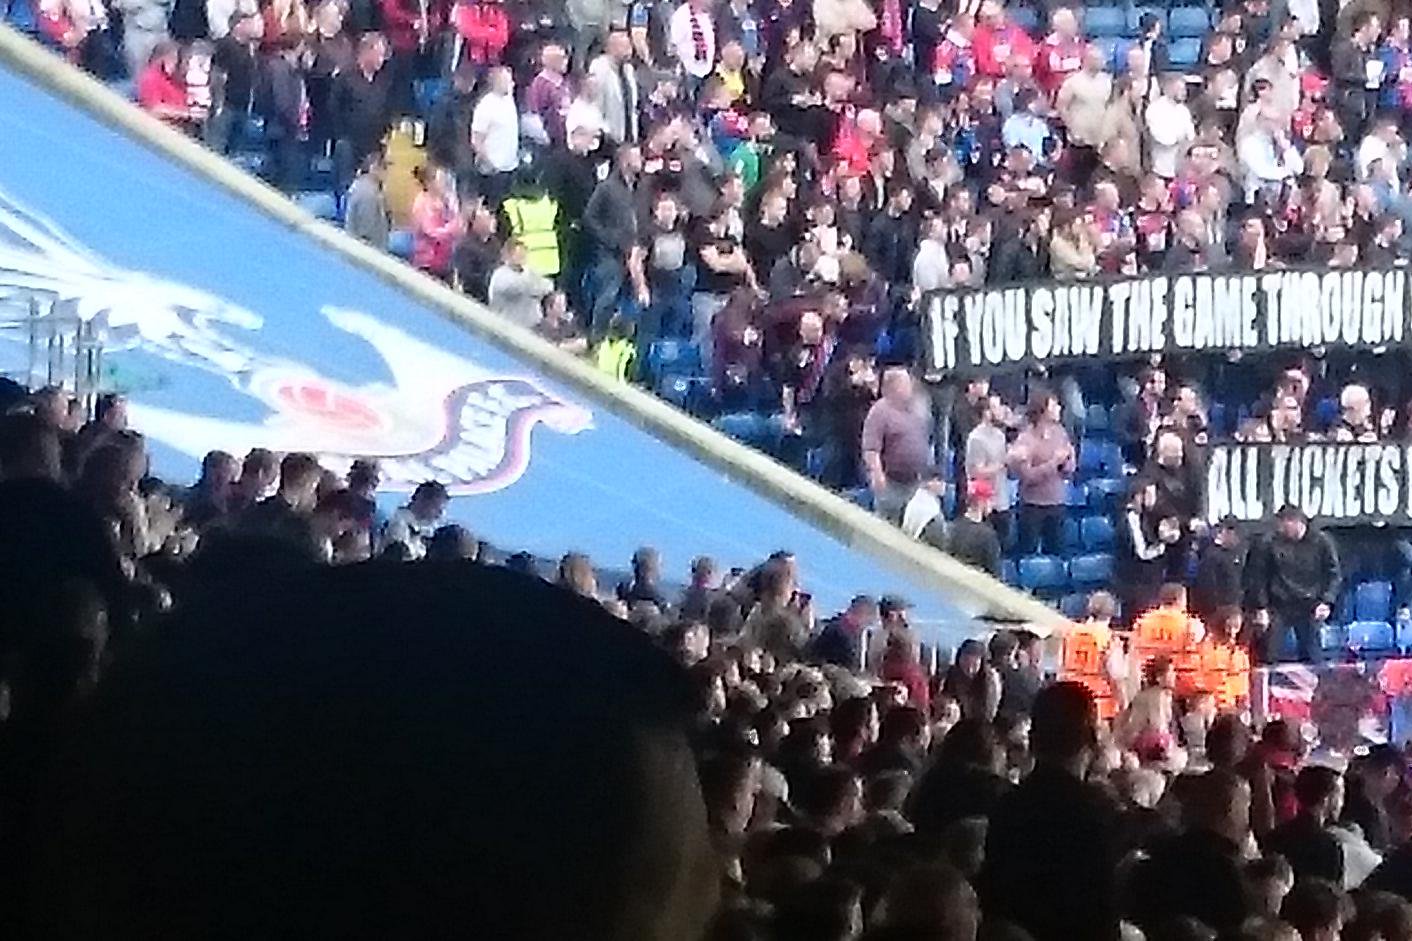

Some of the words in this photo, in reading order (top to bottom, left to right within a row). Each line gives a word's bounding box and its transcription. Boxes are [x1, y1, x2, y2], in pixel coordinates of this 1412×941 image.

[930, 295, 959, 369] IF
[964, 287, 1026, 366] YOU
[1030, 286, 1104, 358] SAW
[1108, 276, 1168, 353] THE
[1172, 275, 1258, 348] GAME
[1262, 270, 1404, 347] THROUGH
[1207, 445, 1263, 526] ALL
[1271, 444, 1401, 519] TICKETS
